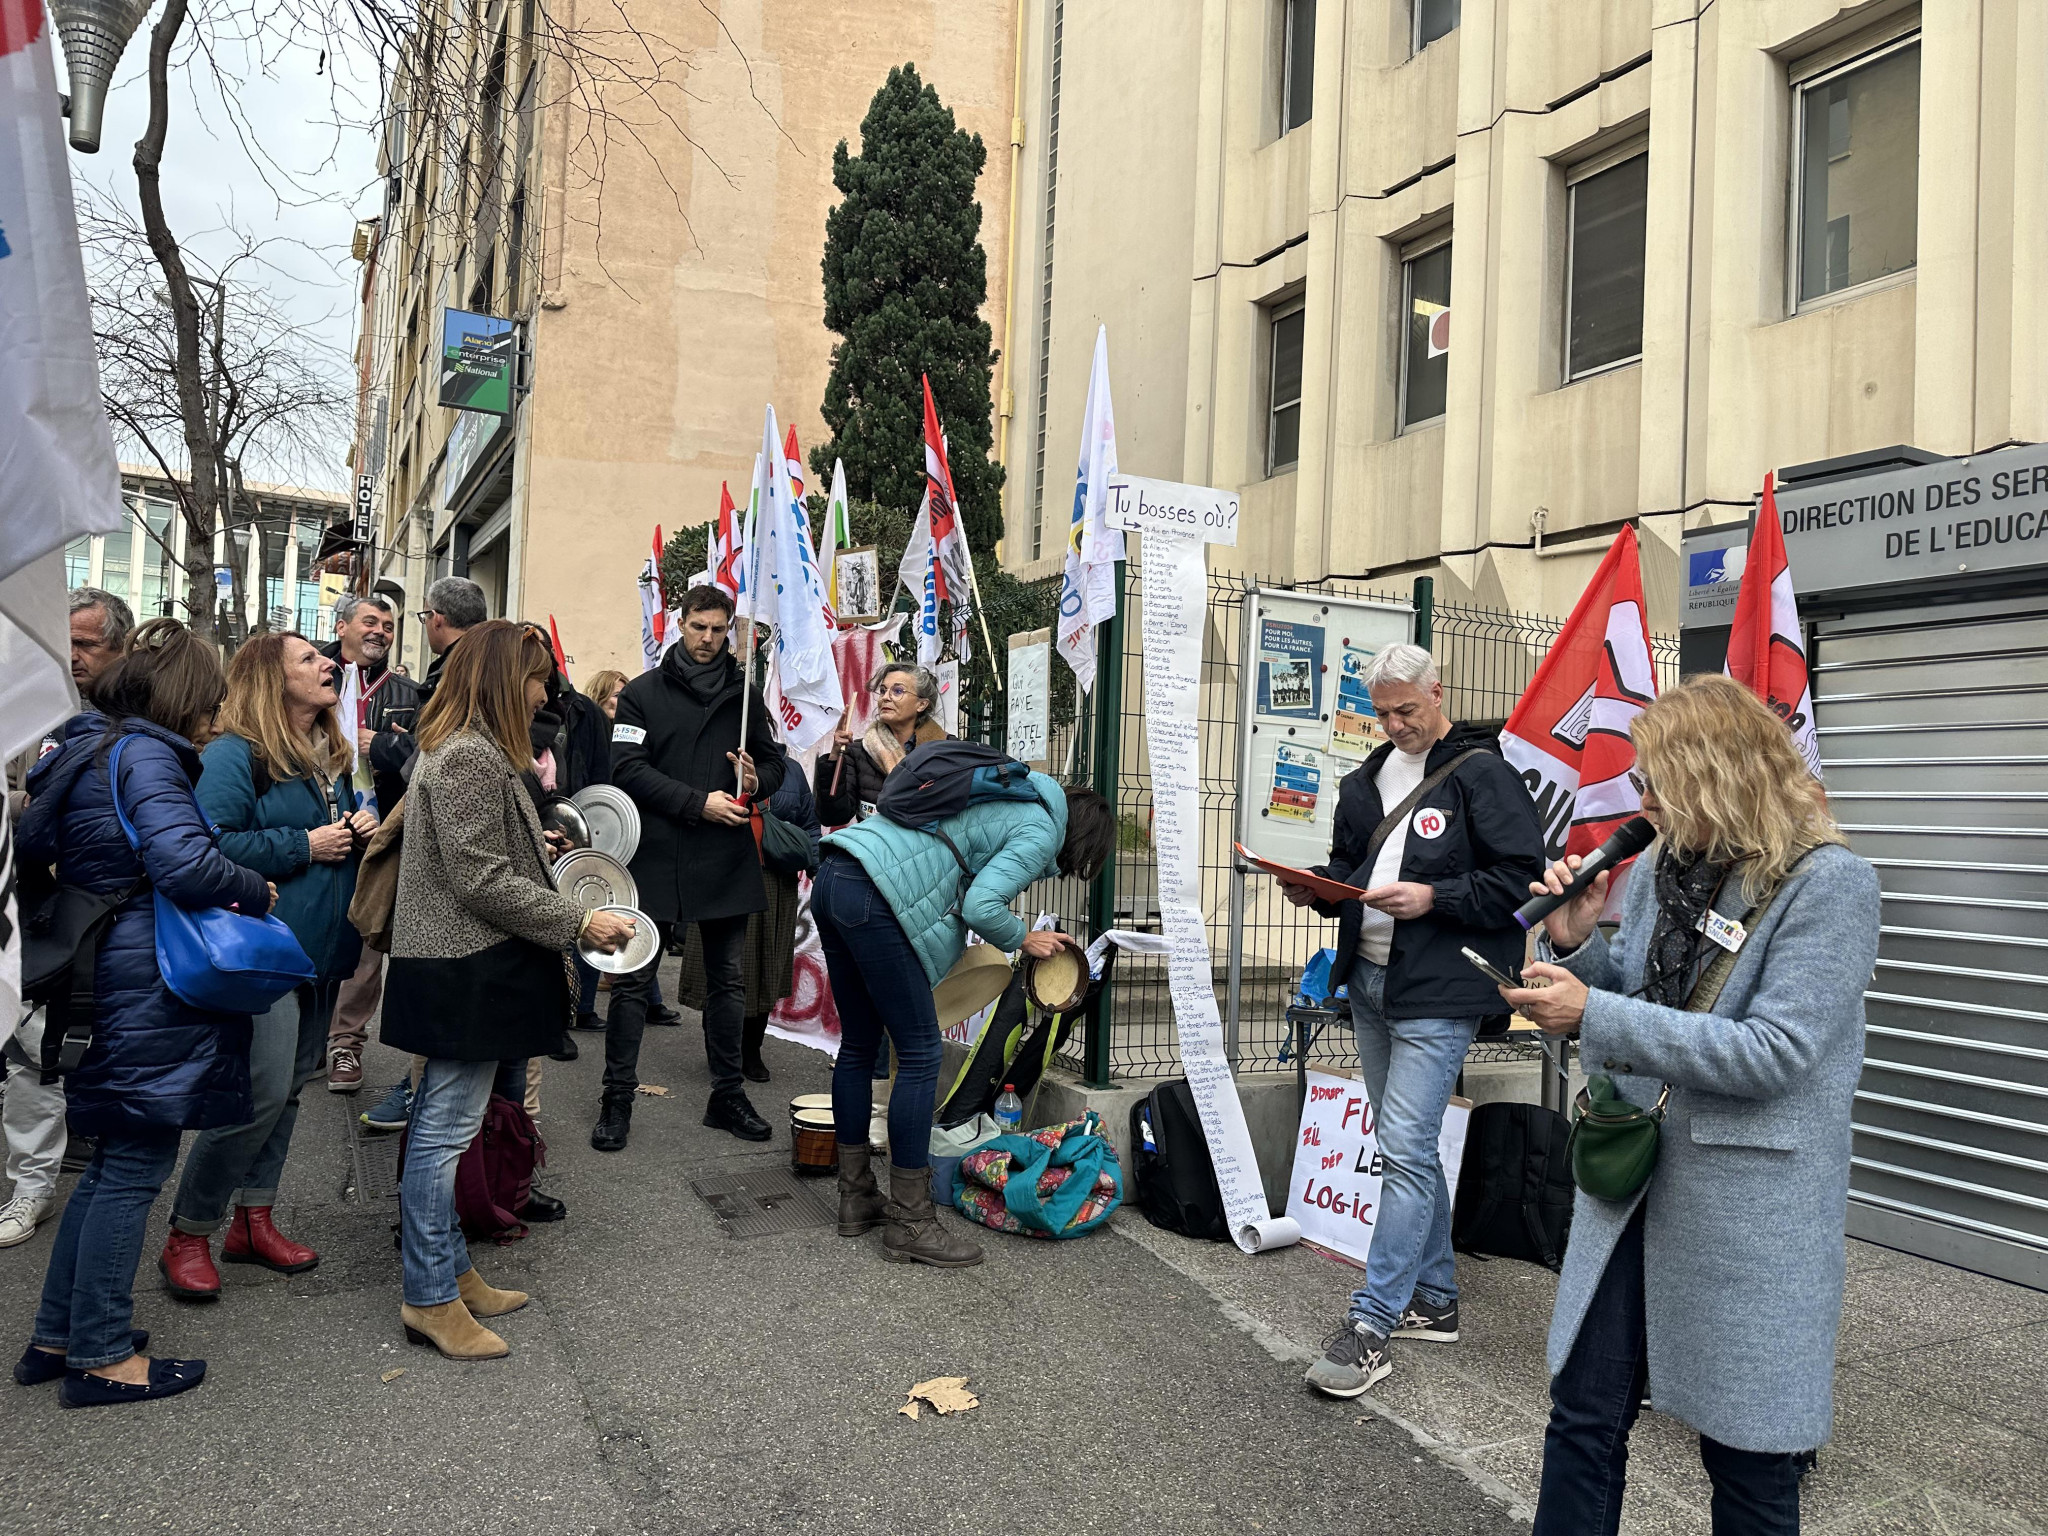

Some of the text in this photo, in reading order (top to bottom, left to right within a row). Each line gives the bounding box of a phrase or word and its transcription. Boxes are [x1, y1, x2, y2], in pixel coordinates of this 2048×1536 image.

[464, 336, 493, 347] Alamo
[451, 349, 506, 364] enterprise
[464, 366, 498, 378] National
[356, 476, 372, 540] HOTEL
[1109, 485, 1130, 513] Tu
[1138, 490, 1196, 524] bosses
[1783, 489, 1914, 534] DIRECTION
[1926, 477, 1981, 511] DES
[1886, 528, 1920, 559] DE
[1689, 584, 1738, 596] Liberté Égalité
[1689, 598, 1734, 610] RÉPUBLIQUE
[1291, 639, 1313, 647] AUTRES,
[1421, 815, 1440, 835] FO
[1734, 930, 1744, 941] 13
[1321, 1149, 1343, 1170] DÉP
